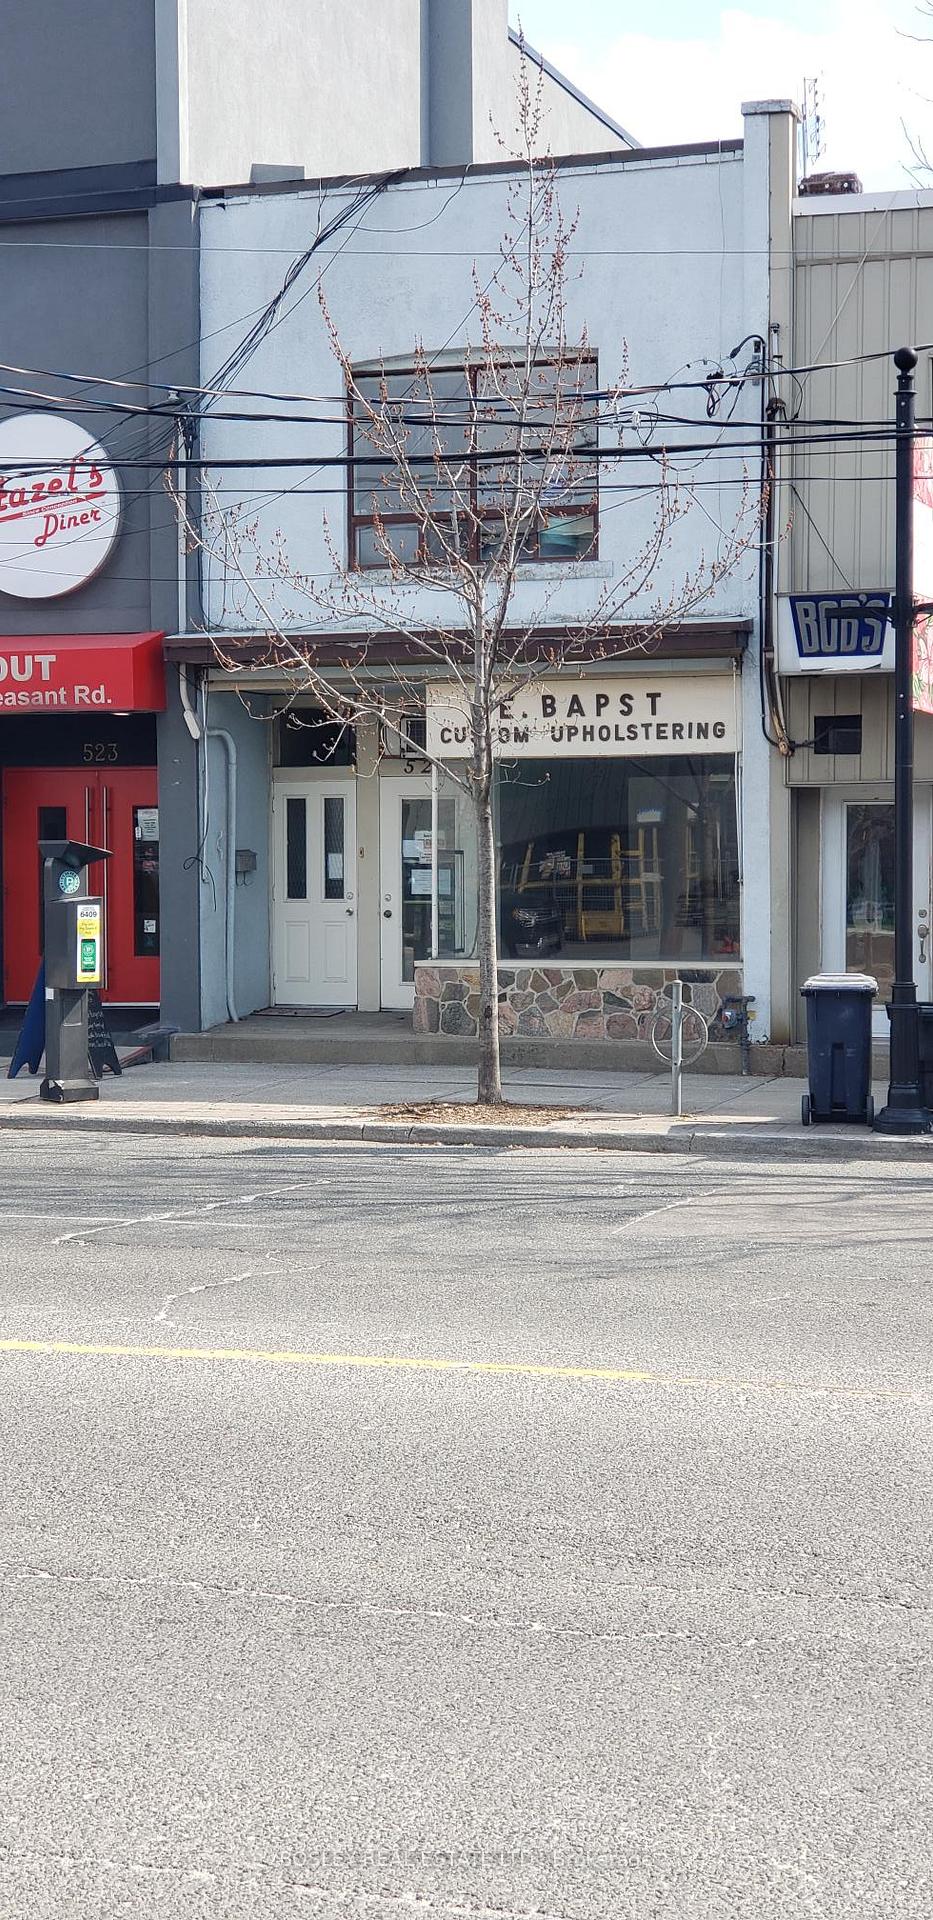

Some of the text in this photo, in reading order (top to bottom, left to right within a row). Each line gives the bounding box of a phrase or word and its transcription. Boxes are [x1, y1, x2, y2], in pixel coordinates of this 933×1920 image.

[0, 457, 104, 510] azel's
[34, 508, 102, 547] Diner
[0, 684, 112, 706] asant Rd.
[541, 692, 662, 718] BAPST
[551, 721, 726, 743] UPHOLSTERING
[81, 743, 118, 762] 523
[79, 910, 98, 918] 6409
